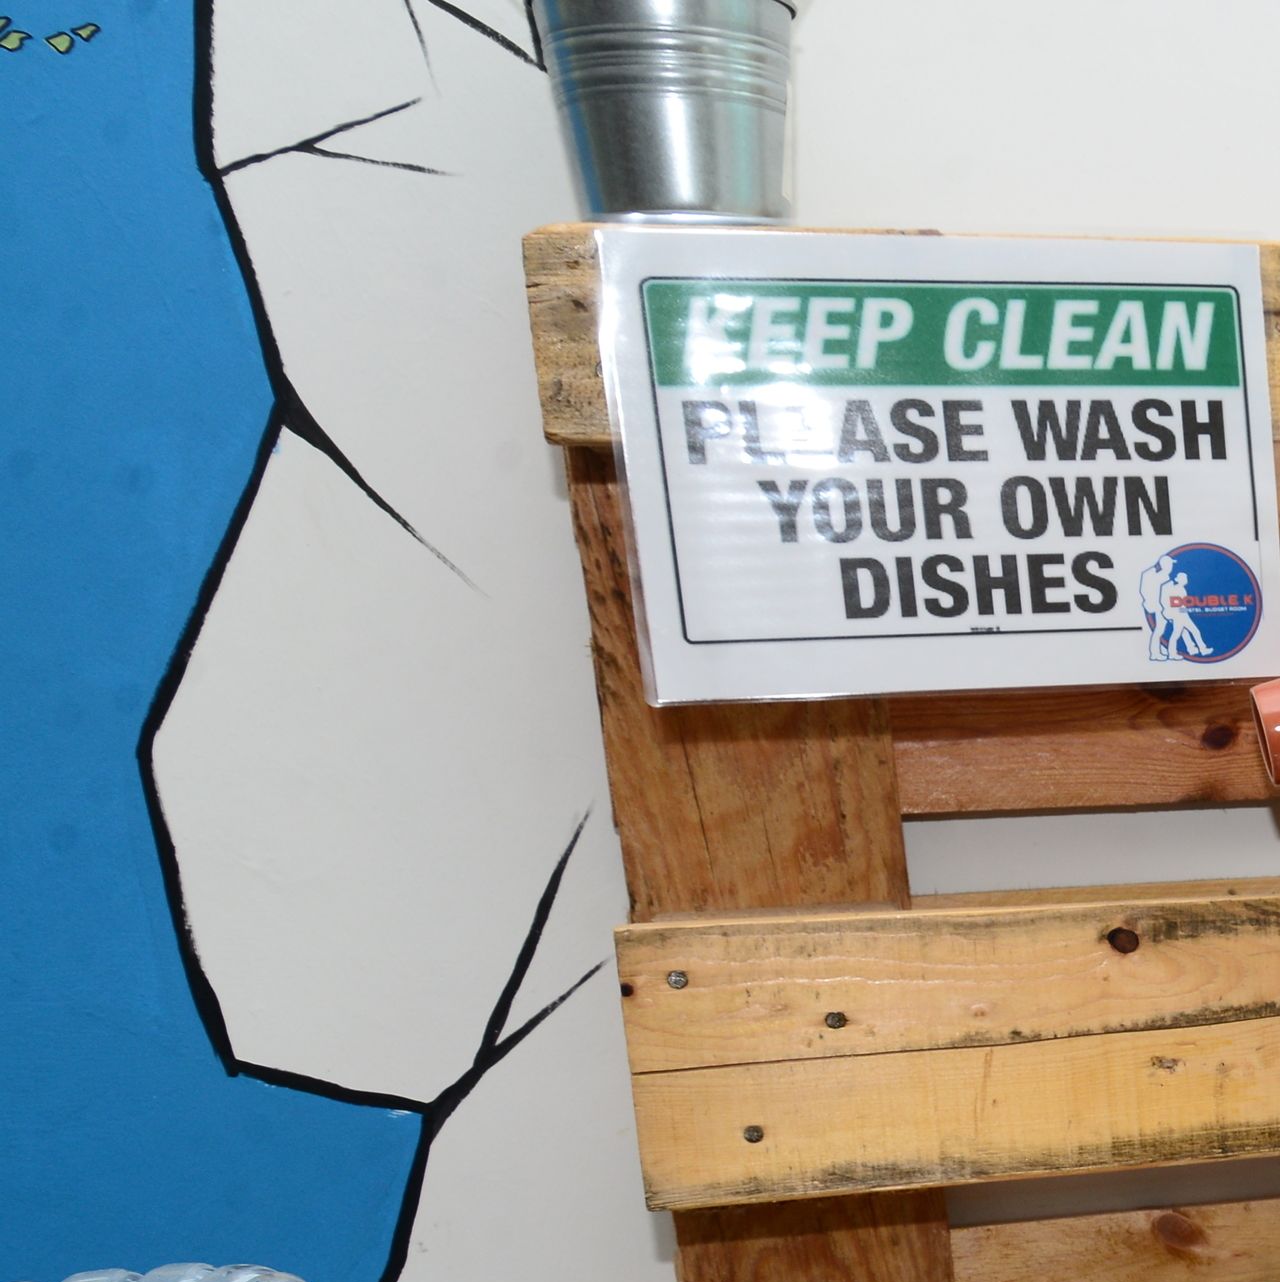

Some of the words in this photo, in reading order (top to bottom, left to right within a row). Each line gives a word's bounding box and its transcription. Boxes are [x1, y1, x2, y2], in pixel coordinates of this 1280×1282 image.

[683, 296, 914, 373] KEEP
[944, 299, 1216, 372] CLEAN
[682, 398, 988, 466] PLASE
[1012, 399, 1227, 462] WASH
[757, 476, 974, 544] YOUR
[1000, 475, 1173, 540] OWN
[839, 550, 1119, 620] DISHES
[1169, 594, 1239, 608] DOUBLE
